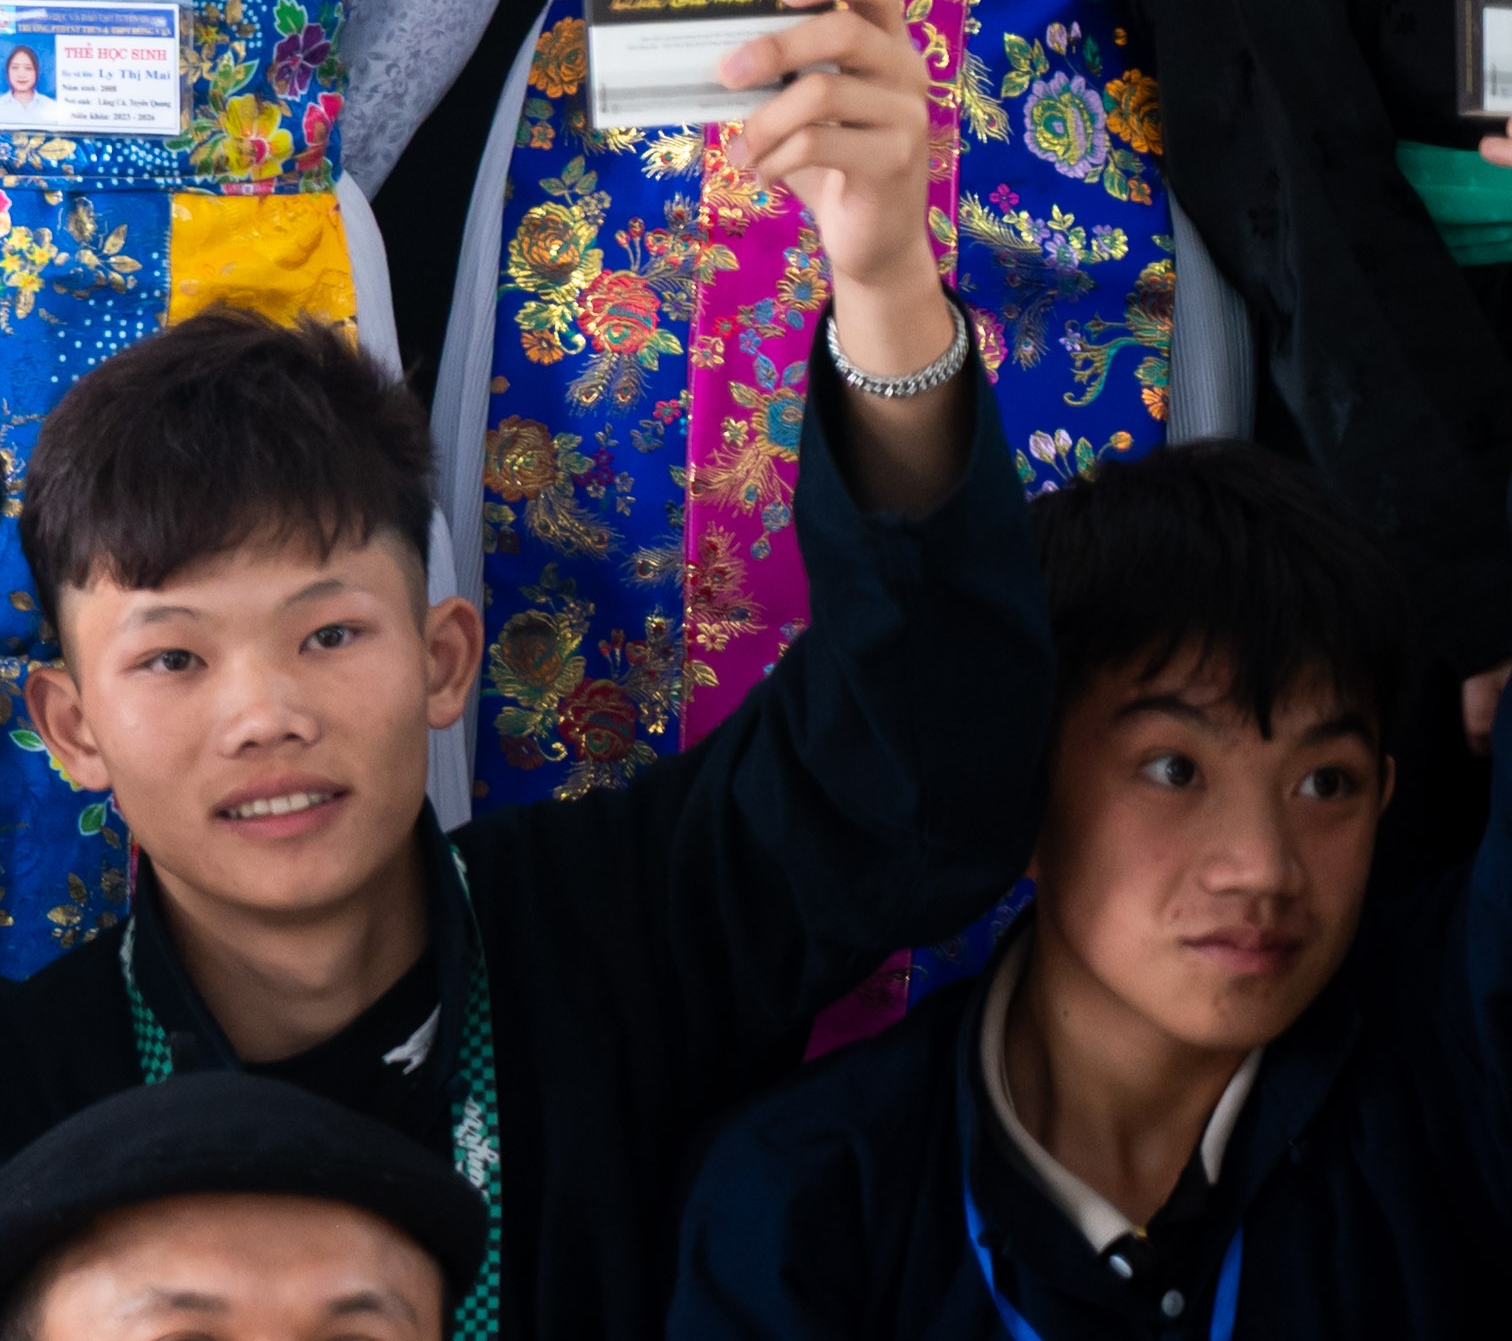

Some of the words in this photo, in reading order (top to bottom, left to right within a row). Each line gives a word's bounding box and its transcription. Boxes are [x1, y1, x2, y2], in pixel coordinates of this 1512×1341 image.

[64, 43, 94, 59] THẺ
[97, 47, 129, 62] HỌC
[131, 48, 167, 61] SINH
[119, 69, 141, 81] Thị
[145, 69, 171, 80] Mai
